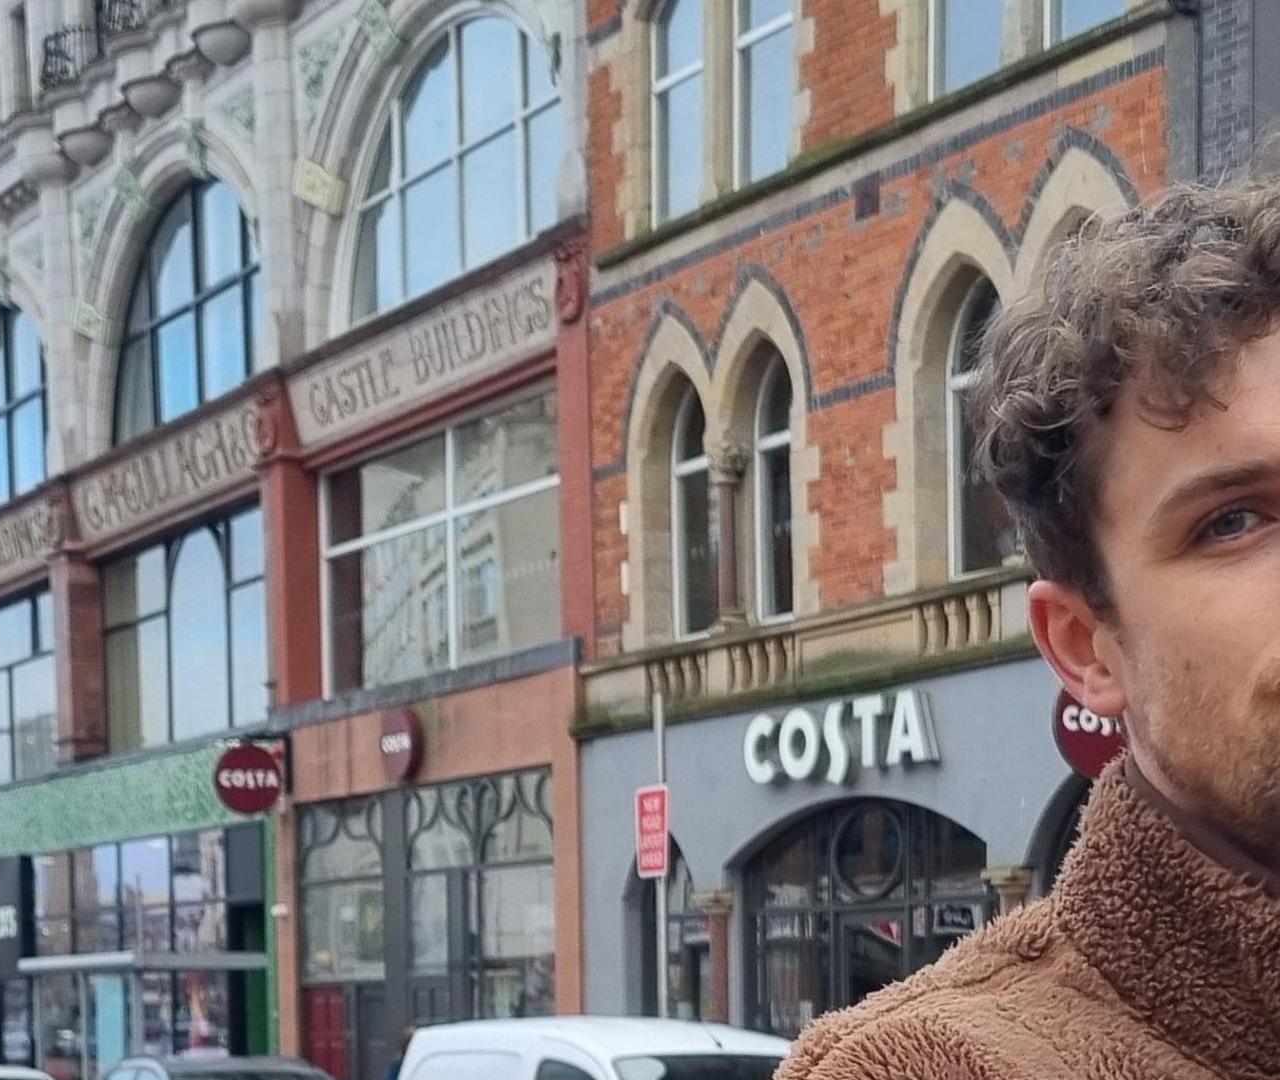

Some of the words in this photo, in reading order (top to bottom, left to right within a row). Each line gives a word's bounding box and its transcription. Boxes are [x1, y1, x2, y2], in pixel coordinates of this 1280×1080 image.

[308, 348, 400, 426] CASTLE
[408, 277, 551, 386] BUILDINGS
[743, 688, 930, 785] COSTA
[1062, 704, 1120, 737] COS
[219, 768, 278, 789] COSTA
